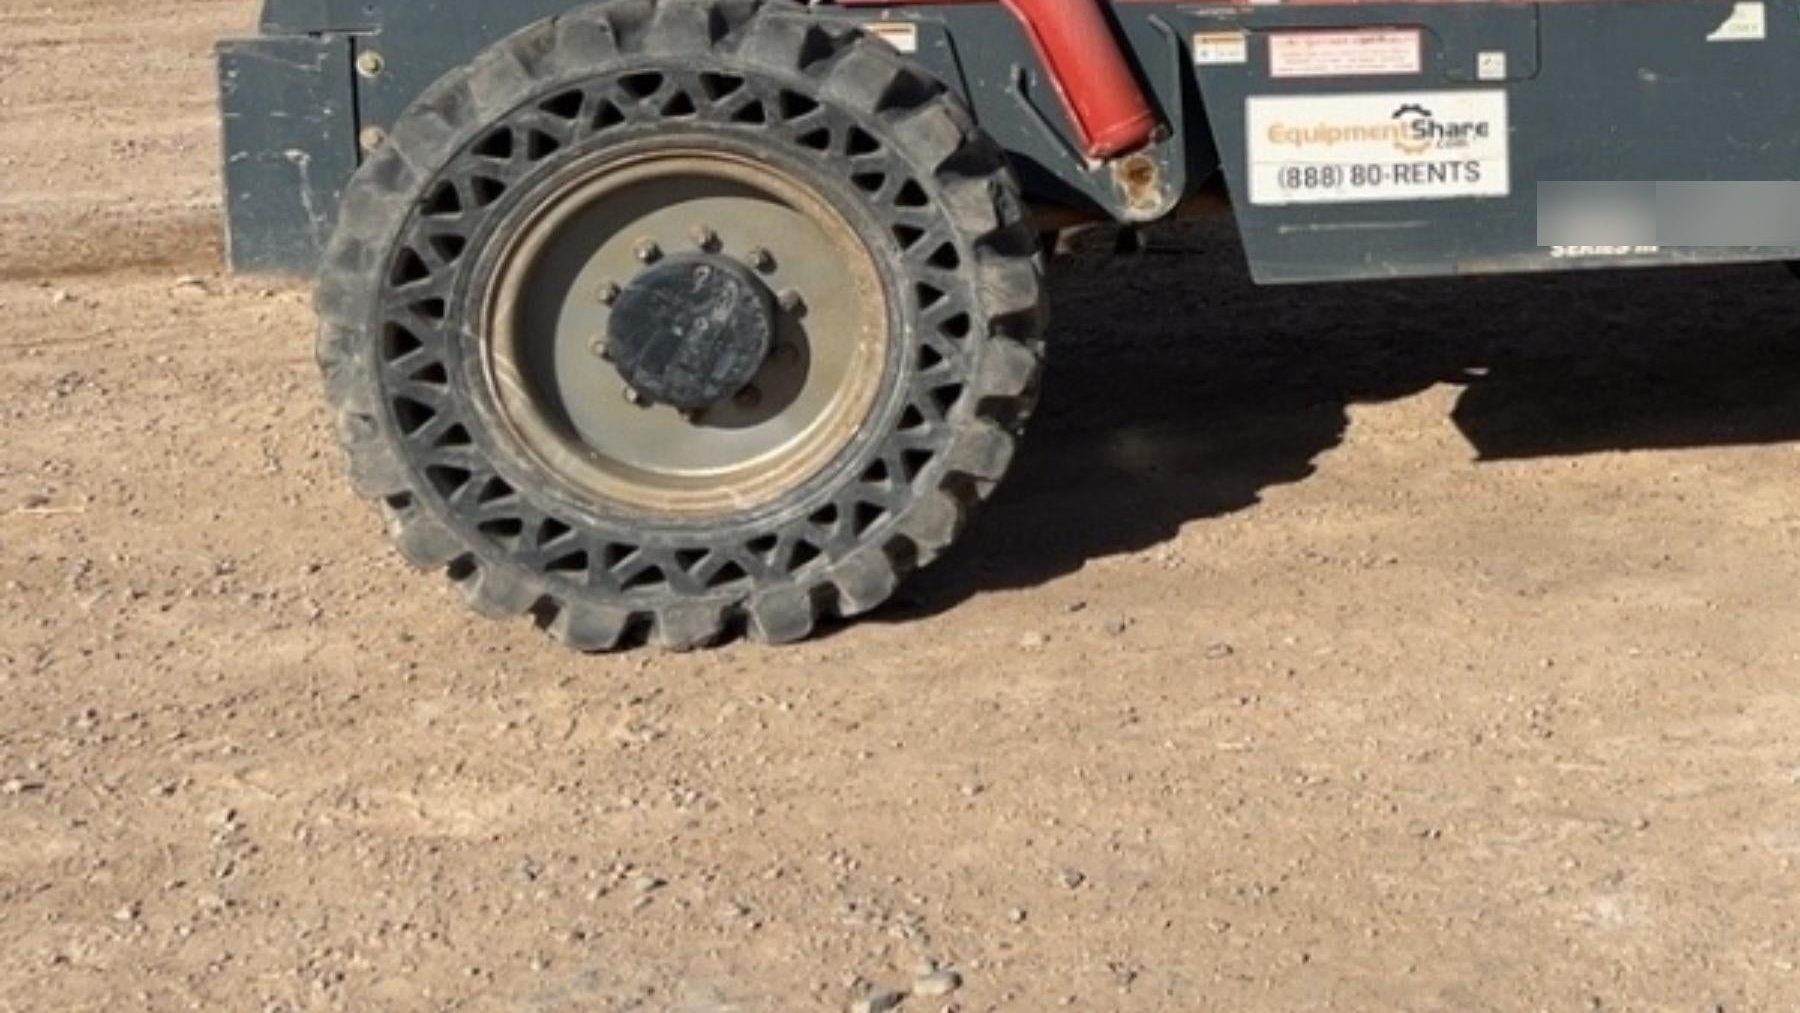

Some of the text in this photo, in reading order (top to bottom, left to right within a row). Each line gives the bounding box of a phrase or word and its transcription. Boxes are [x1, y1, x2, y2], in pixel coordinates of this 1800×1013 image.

[1267, 118, 1489, 148] EquipmentShare
[1277, 160, 1481, 189] (888) 80-RENTS
